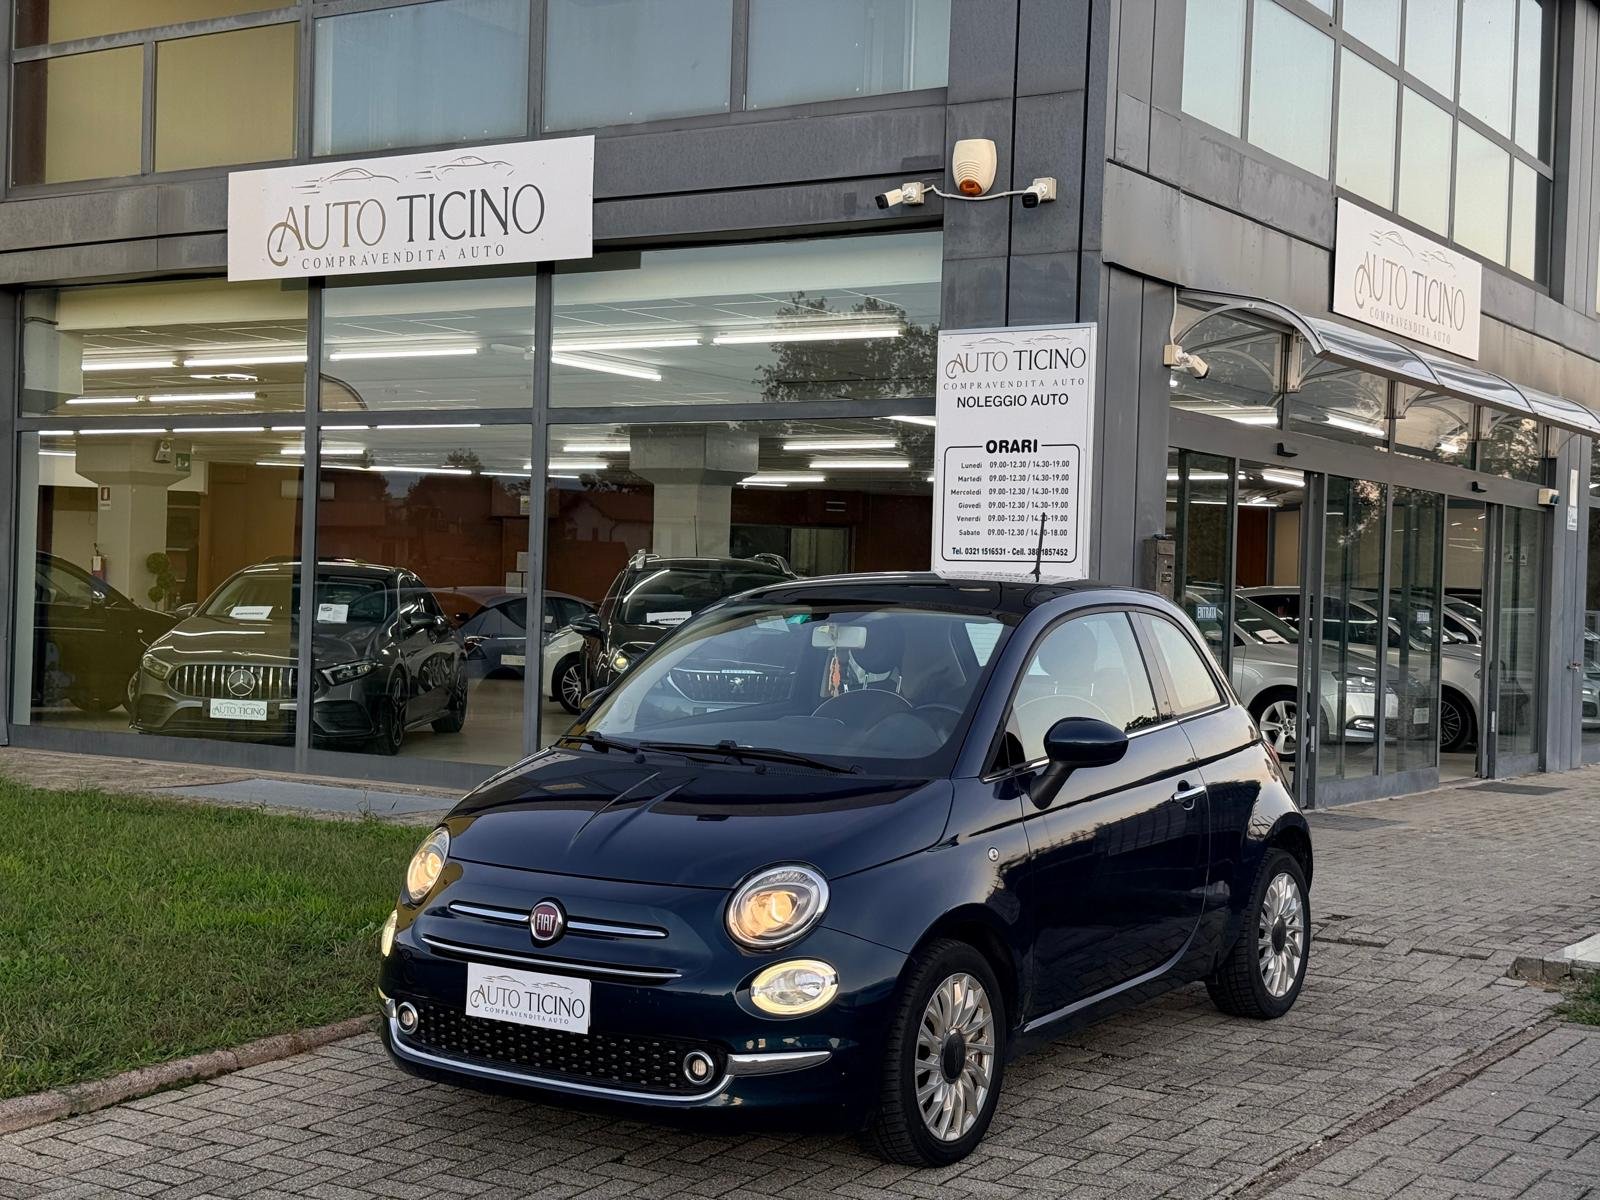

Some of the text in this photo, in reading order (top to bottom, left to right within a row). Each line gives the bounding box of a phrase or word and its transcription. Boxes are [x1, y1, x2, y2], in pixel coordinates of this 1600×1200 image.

[267, 184, 545, 267] AUTO TICINO
[302, 244, 505, 270] COMPRAVENDITA AUTO
[1354, 251, 1465, 331] AUTO TICINO
[1369, 306, 1451, 345] COMPRAVENDITA AUTO
[945, 347, 1086, 380] AUTO TICINO
[943, 377, 1085, 391] COMPRAVENDITA AUTO
[957, 393, 1069, 408] NOLEGGIO AUTO
[985, 439, 1038, 454] ORARI
[952, 547, 963, 555] Tel.
[964, 547, 980, 555] 0321
[981, 547, 1006, 555] 1516531
[1012, 548, 1026, 556] Cell.
[536, 913, 555, 931] FIAT
[470, 984, 585, 1019] AUTO TICINO
[484, 1006, 569, 1025] COMPRAVENDITA AUTO
